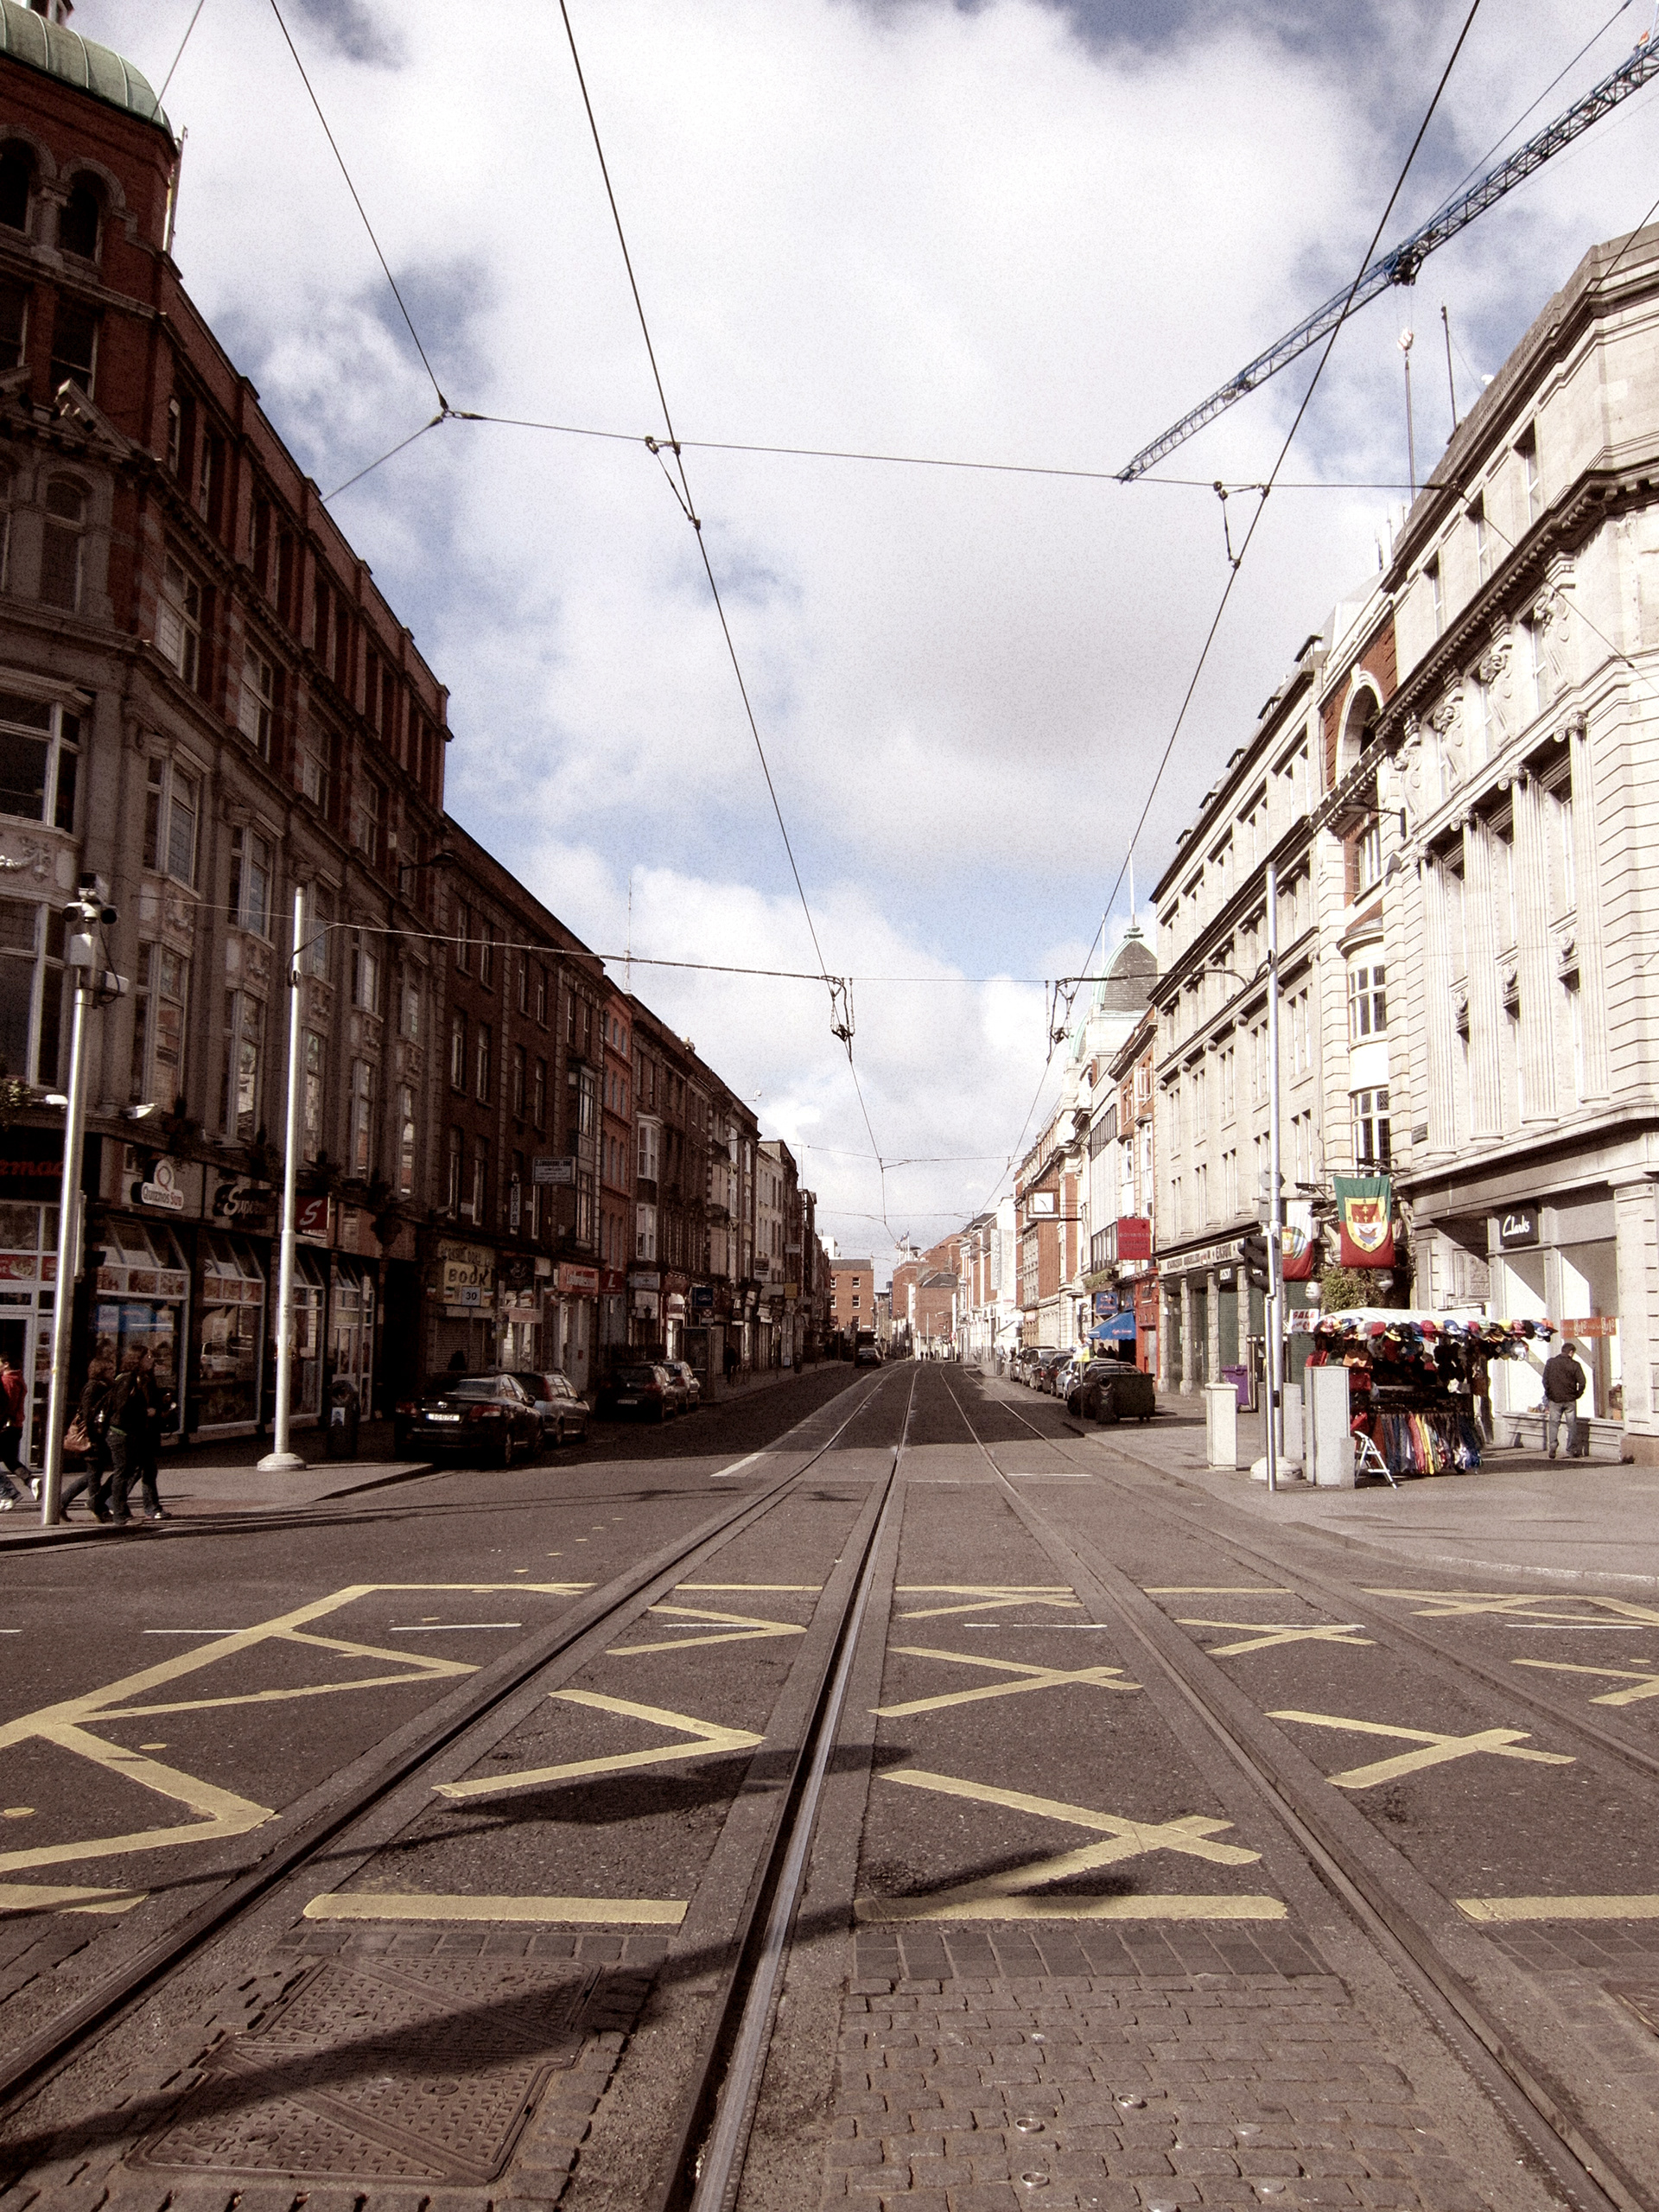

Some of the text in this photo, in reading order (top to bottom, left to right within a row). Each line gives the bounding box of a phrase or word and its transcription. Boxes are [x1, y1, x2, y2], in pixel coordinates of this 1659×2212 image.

[299, 1199, 323, 1226] S
[1502, 1214, 1530, 1237] Clarks
[465, 1291, 477, 1300] 30
[1293, 1311, 1316, 1319] SALE
